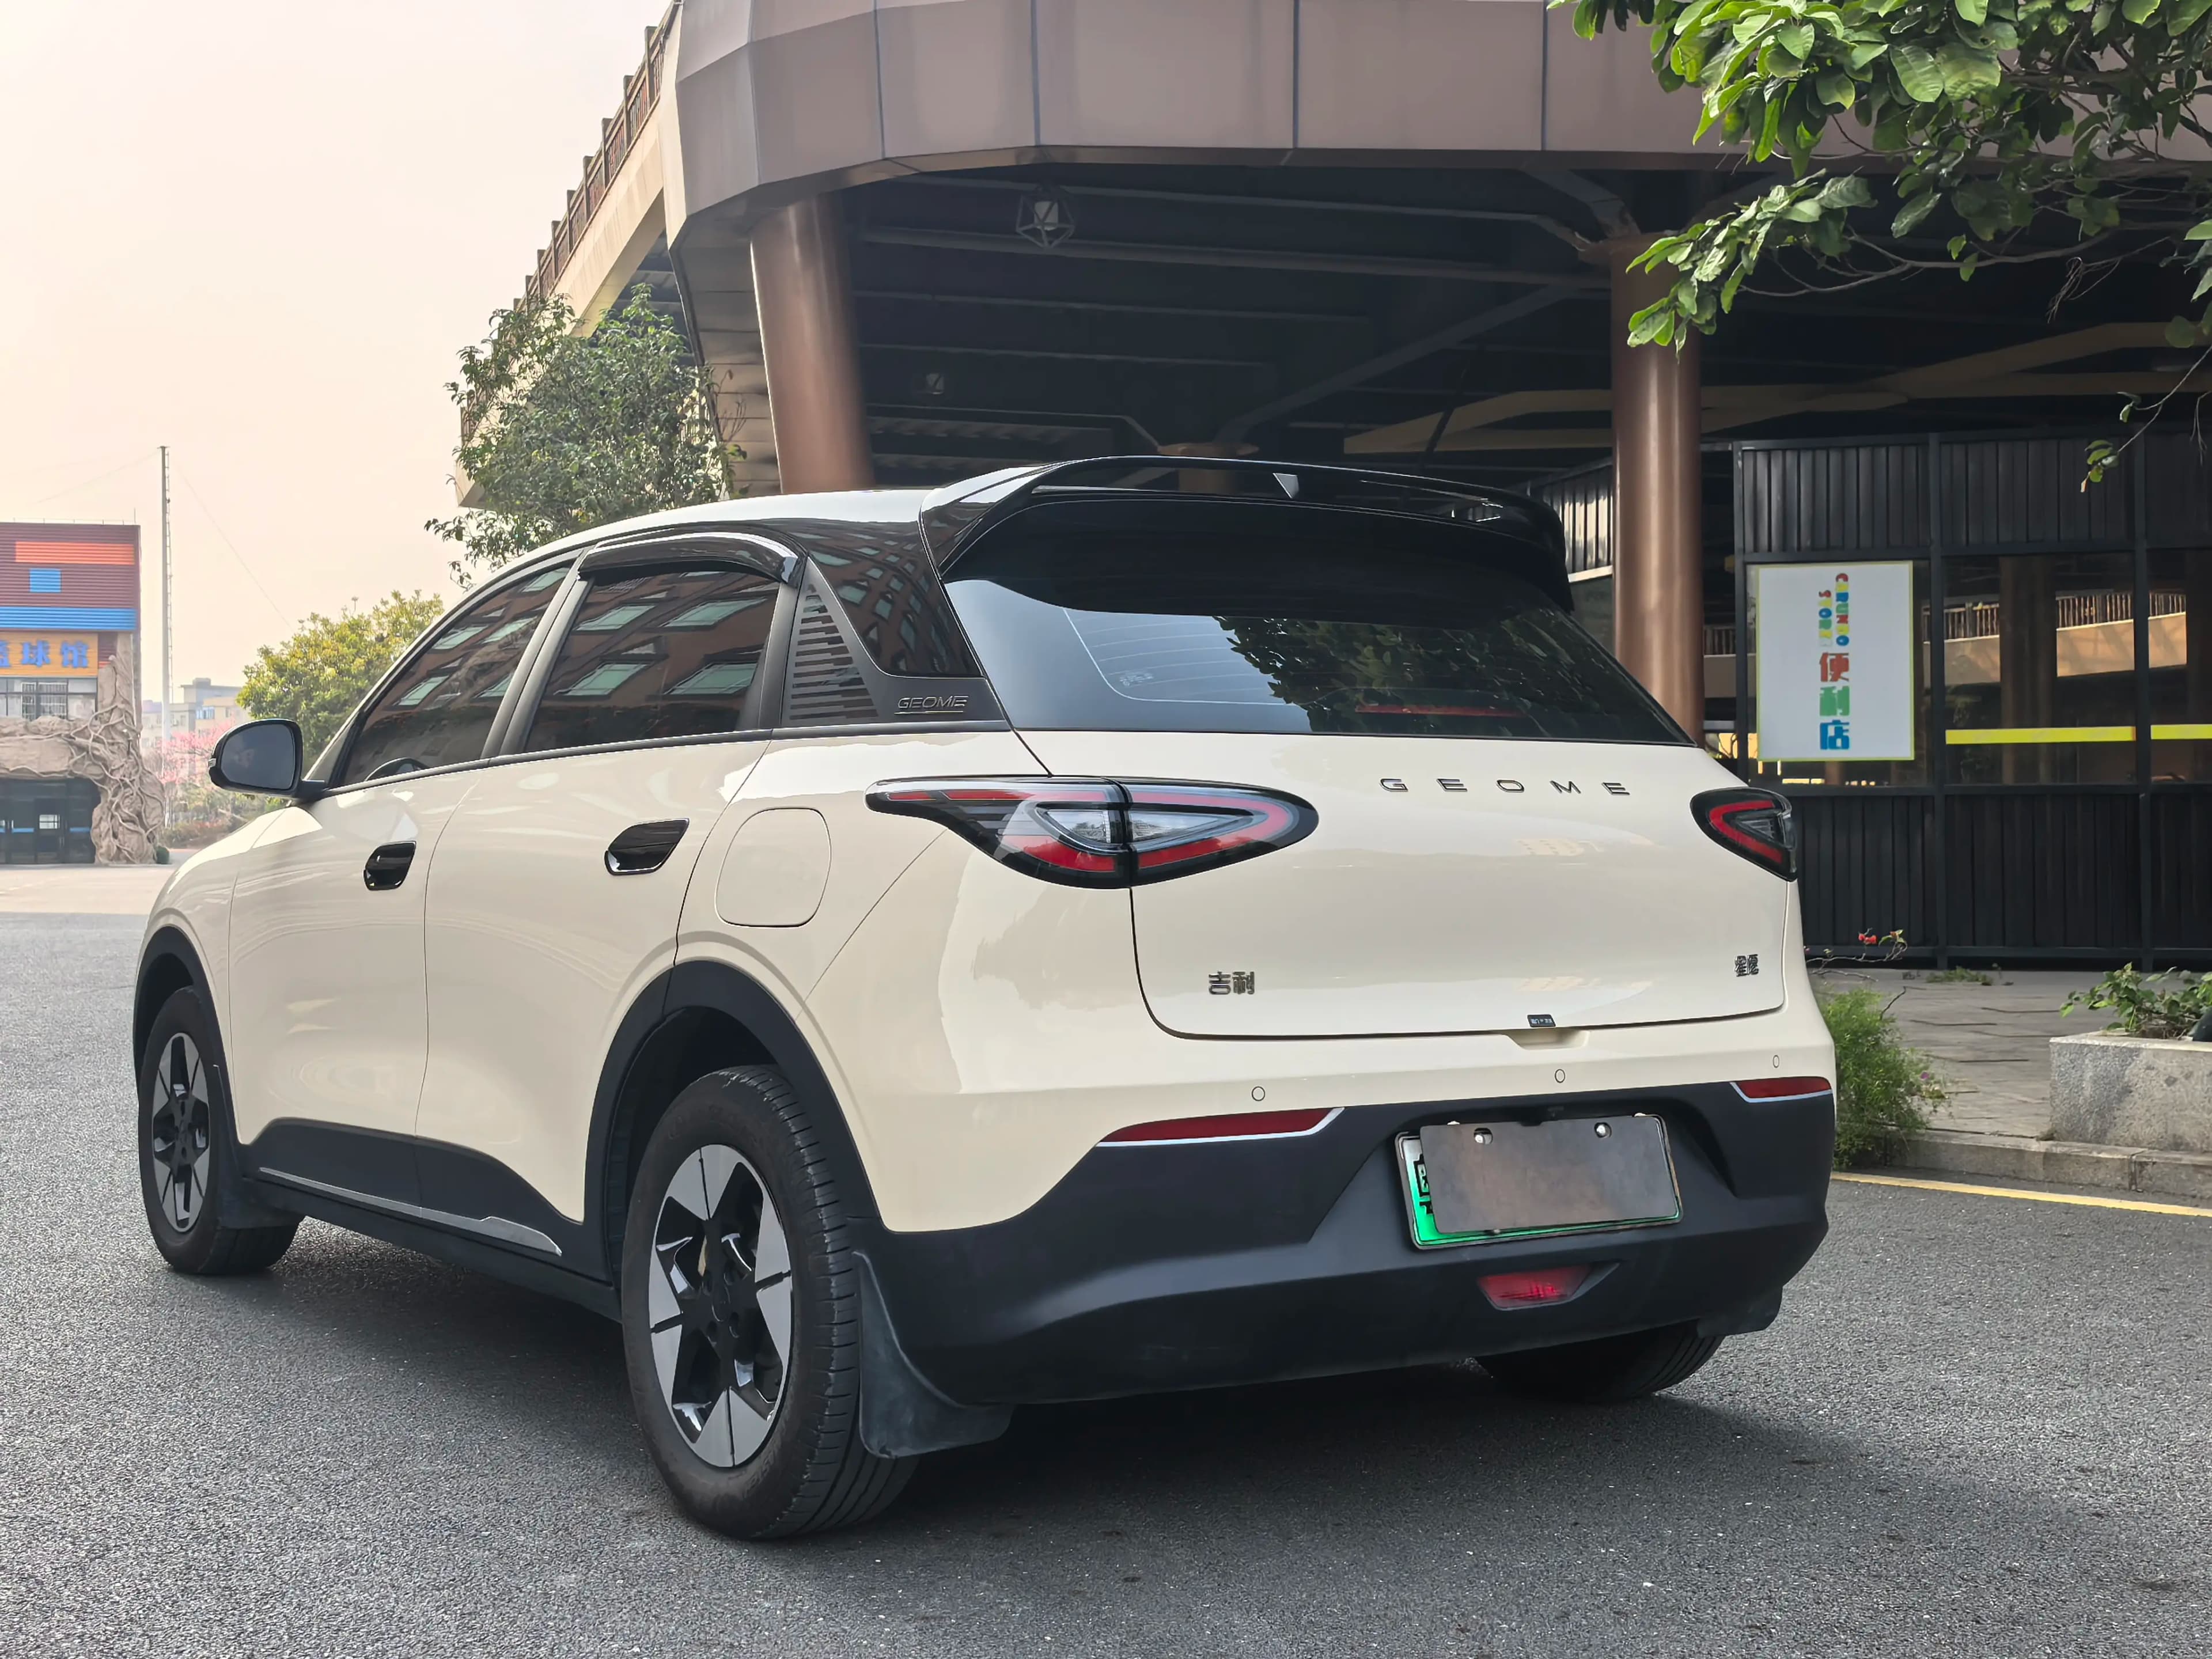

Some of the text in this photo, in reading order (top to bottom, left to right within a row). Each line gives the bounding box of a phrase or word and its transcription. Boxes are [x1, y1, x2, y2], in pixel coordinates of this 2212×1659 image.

[897, 695, 969, 709] GEOME
[1819, 652, 1850, 750] 便利店
[1380, 778, 1630, 796] GEOME
[1208, 971, 1255, 995] 吉利
